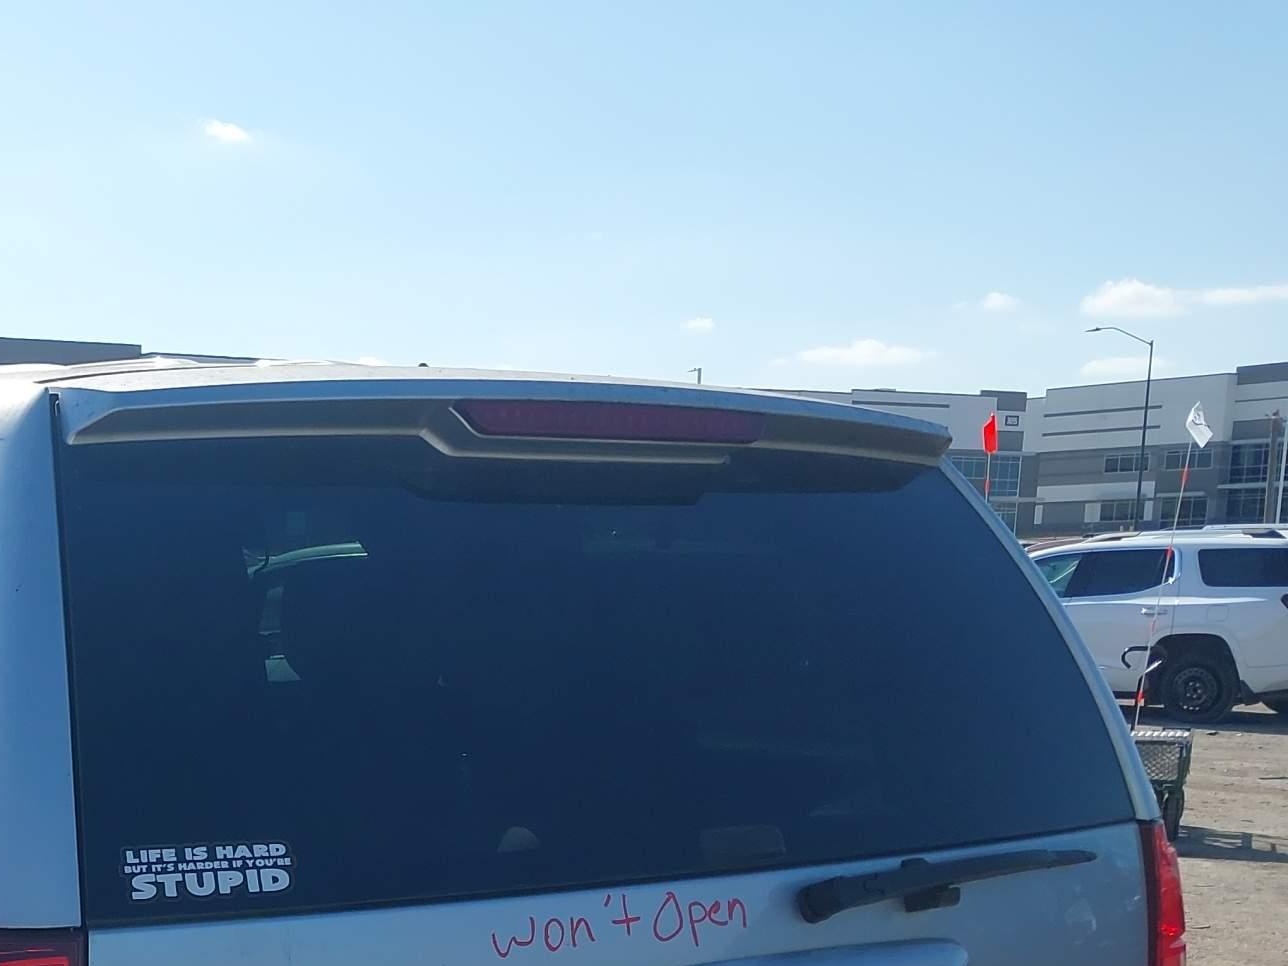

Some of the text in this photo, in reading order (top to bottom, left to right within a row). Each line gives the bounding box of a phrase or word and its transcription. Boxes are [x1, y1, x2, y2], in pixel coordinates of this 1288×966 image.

[123, 857, 292, 874] BUT IT'S HARDER IF YOU'RE
[125, 843, 287, 864] LIFE IS HARD
[131, 868, 290, 901] STUPID
[652, 891, 748, 948] Open
